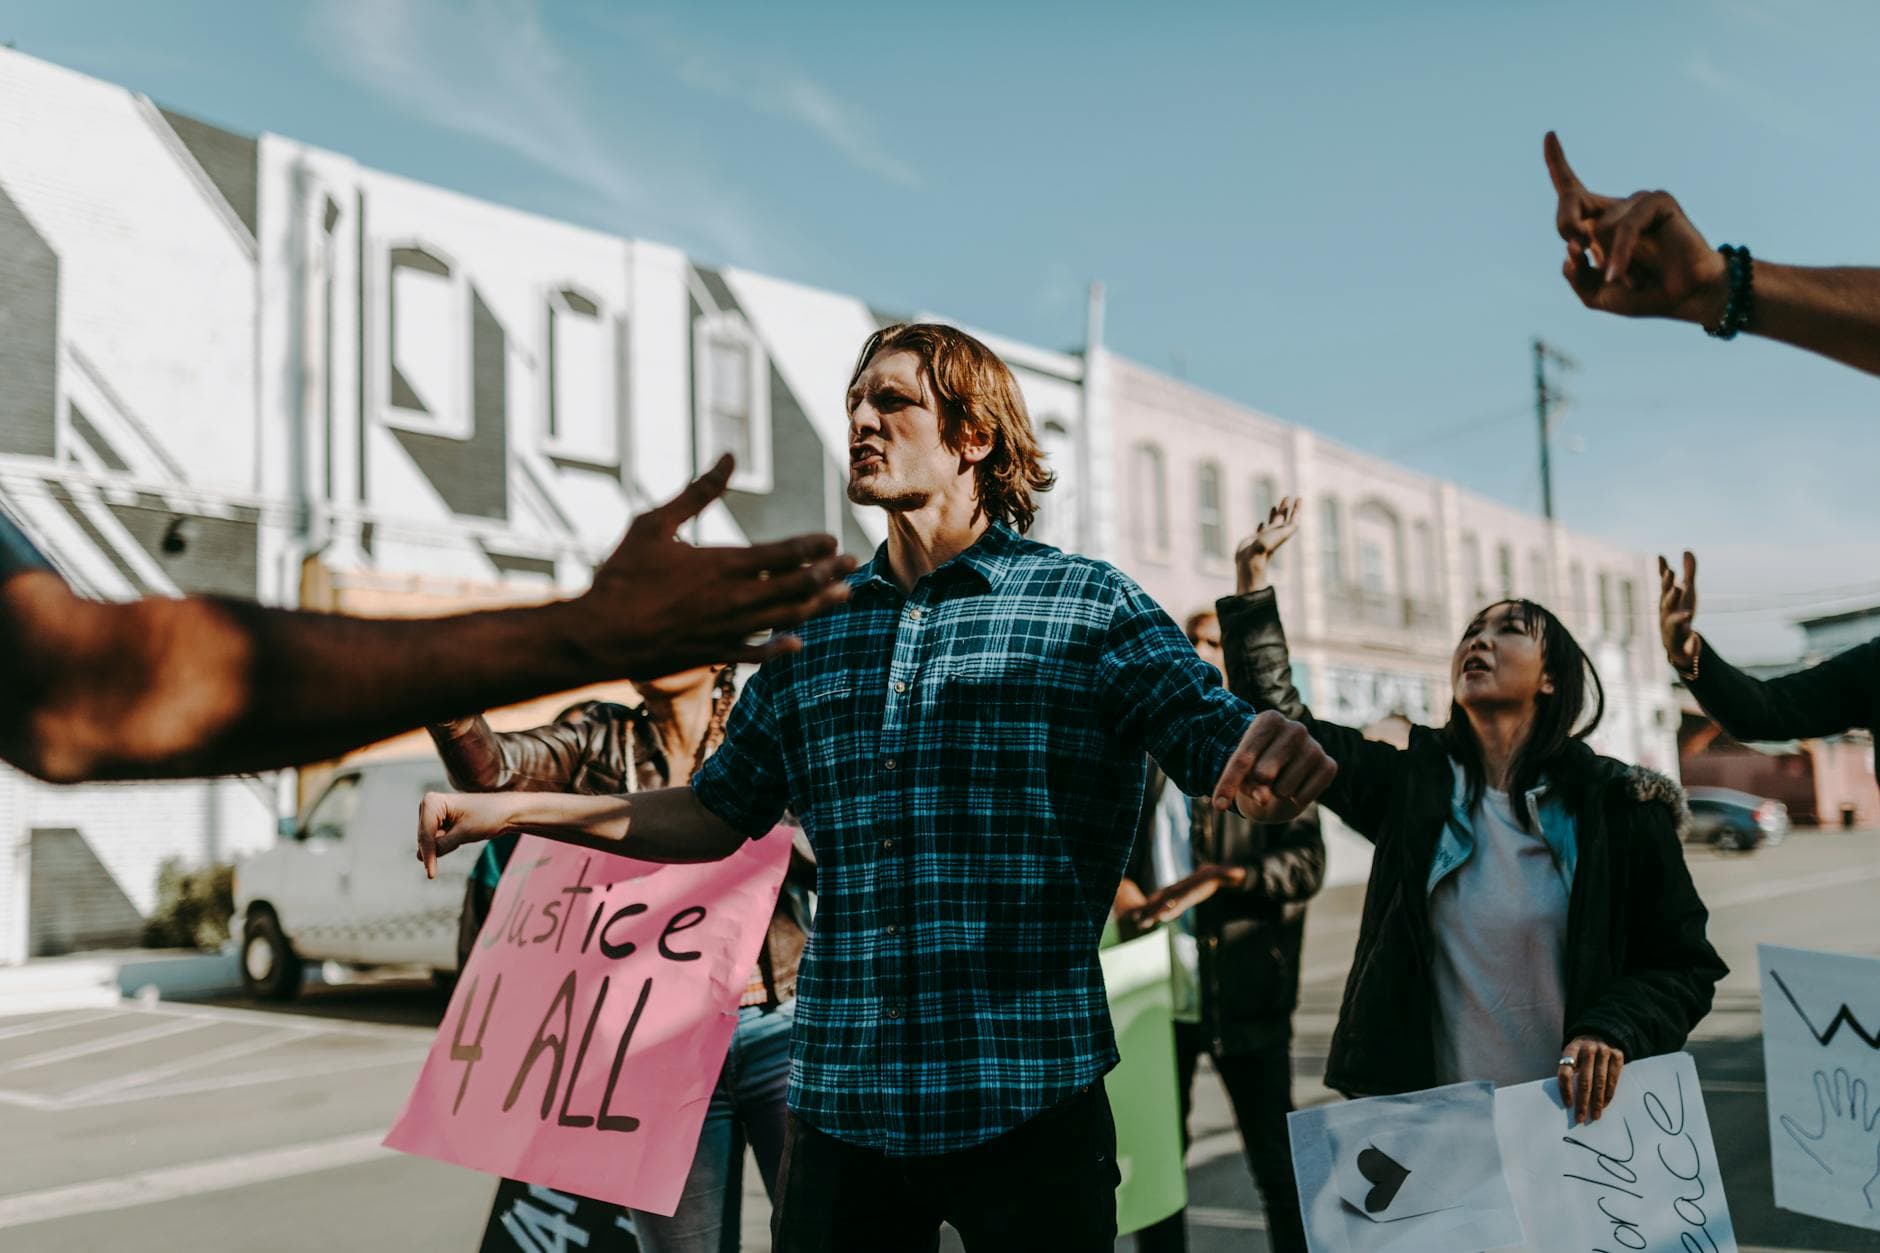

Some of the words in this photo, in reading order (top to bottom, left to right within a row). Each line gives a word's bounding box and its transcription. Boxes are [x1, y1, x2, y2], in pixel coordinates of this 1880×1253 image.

[481, 856, 707, 962] Justice
[450, 972, 502, 1116] 4
[503, 970, 653, 1133] ALL
[1562, 1116, 1647, 1253] orld
